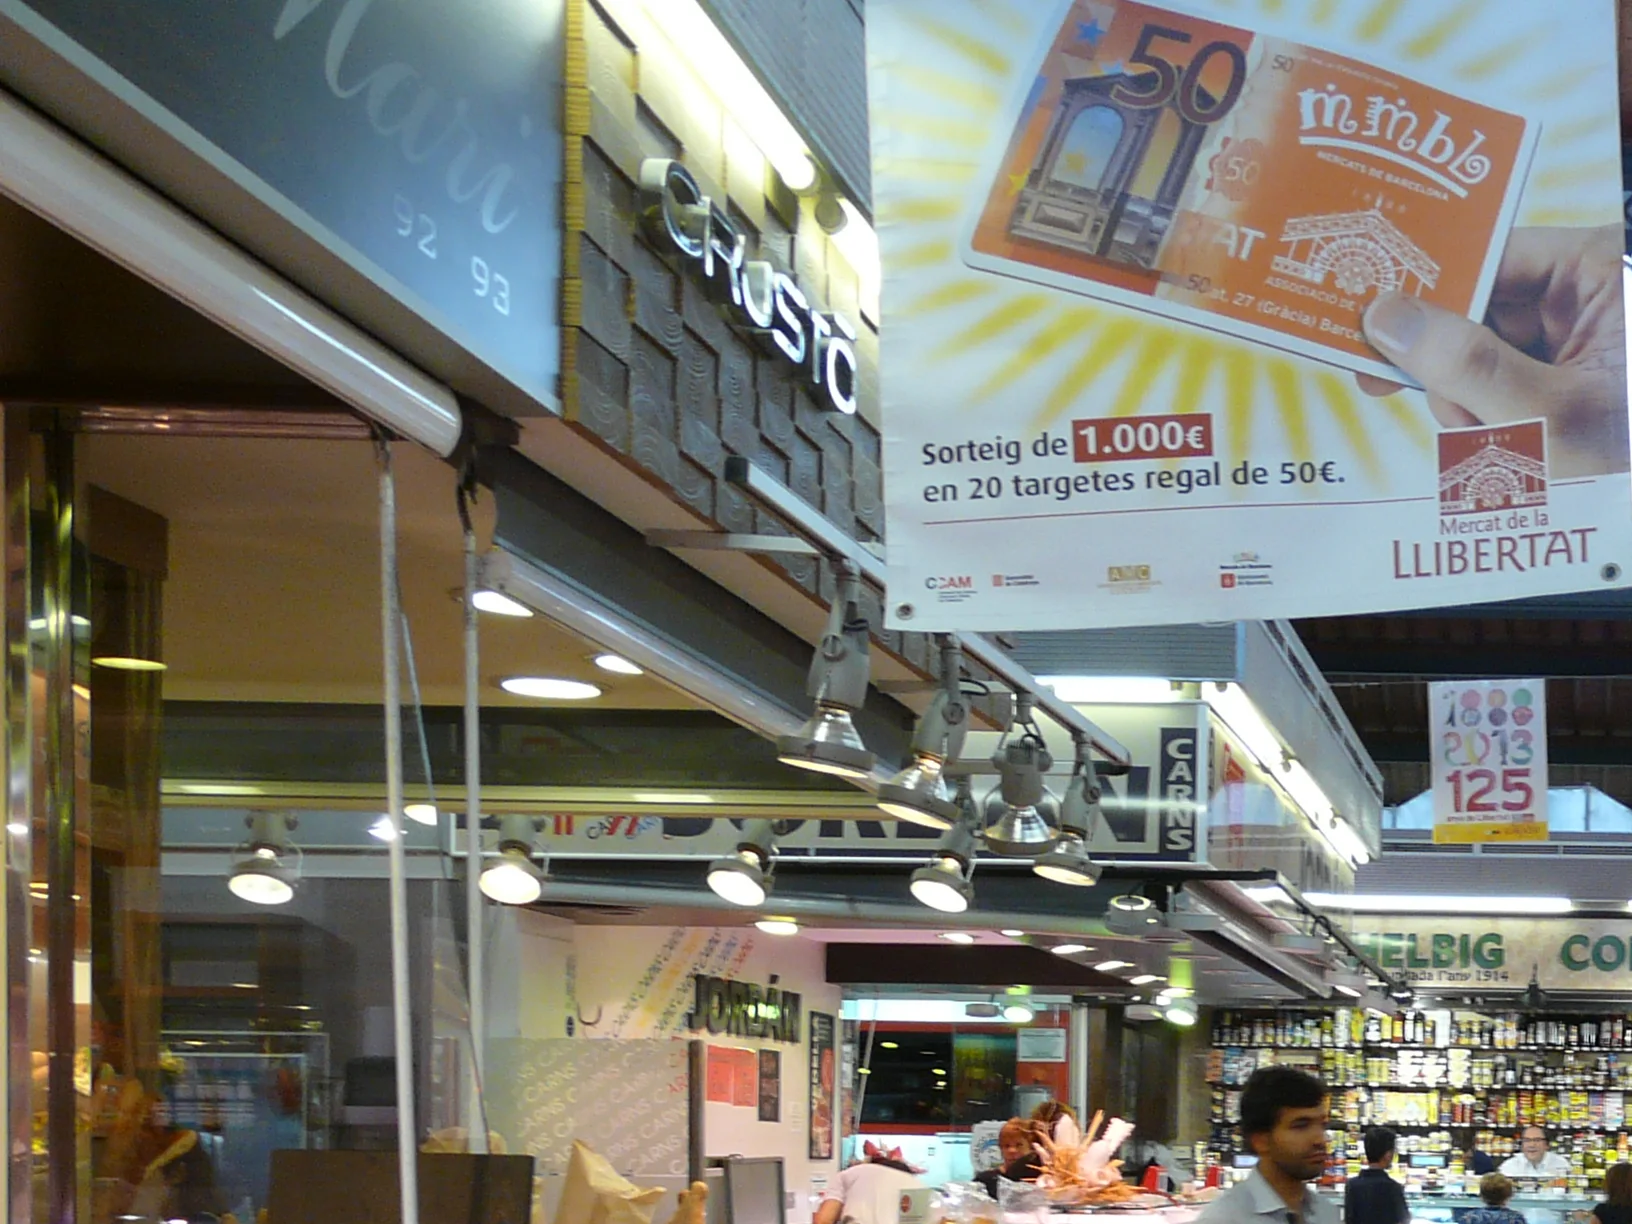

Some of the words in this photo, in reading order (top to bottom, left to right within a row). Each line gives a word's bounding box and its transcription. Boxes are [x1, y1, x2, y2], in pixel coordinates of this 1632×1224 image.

[1110, 23, 1248, 126] 50
[1271, 54, 1295, 74] 50
[1316, 149, 1367, 174] MERCATS
[1369, 166, 1385, 180] DE
[1385, 171, 1450, 202] BARCELONA
[470, 255, 512, 316] 93
[1232, 292, 1255, 308] 27
[922, 434, 1021, 466] Sorteig
[1032, 432, 1068, 457] de
[1079, 420, 1205, 455] 1.000€
[923, 481, 958, 503] en
[967, 476, 1002, 500] 20
[1011, 468, 1135, 501] targetes
[1144, 462, 1221, 494] regal
[1231, 461, 1270, 486] de
[1279, 460, 1346, 485] 50€.
[1439, 516, 1501, 536] Mercat
[1506, 511, 1530, 530] de
[1534, 508, 1549, 528] la
[1392, 527, 1598, 580] LLIBERTAT
[1443, 729, 1534, 767] 2013
[1165, 737, 1194, 851] CARNS
[1446, 768, 1534, 813] 125
[1475, 969, 1509, 982] 1914
